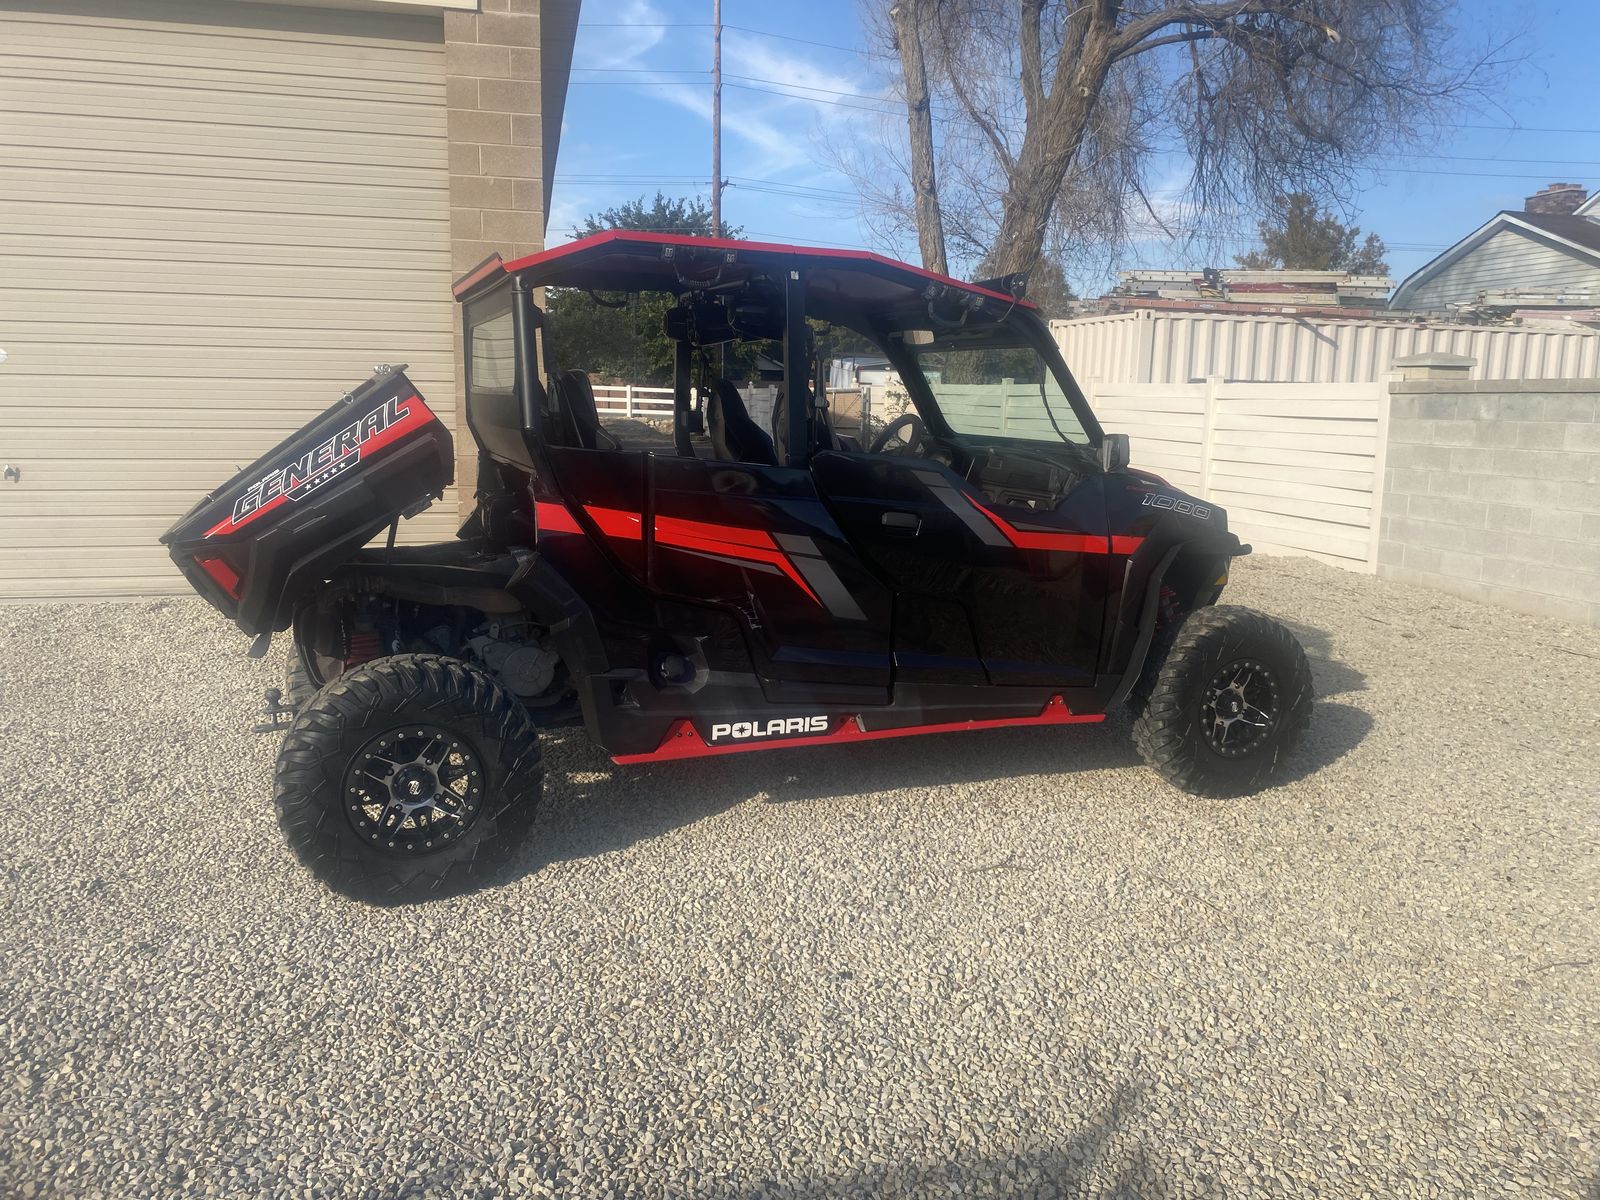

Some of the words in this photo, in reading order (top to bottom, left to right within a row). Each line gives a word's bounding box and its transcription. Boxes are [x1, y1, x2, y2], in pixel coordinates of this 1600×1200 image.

[232, 396, 410, 525] GENERAL
[1142, 493, 1211, 519] 1000
[711, 715, 828, 741] POLARIS
